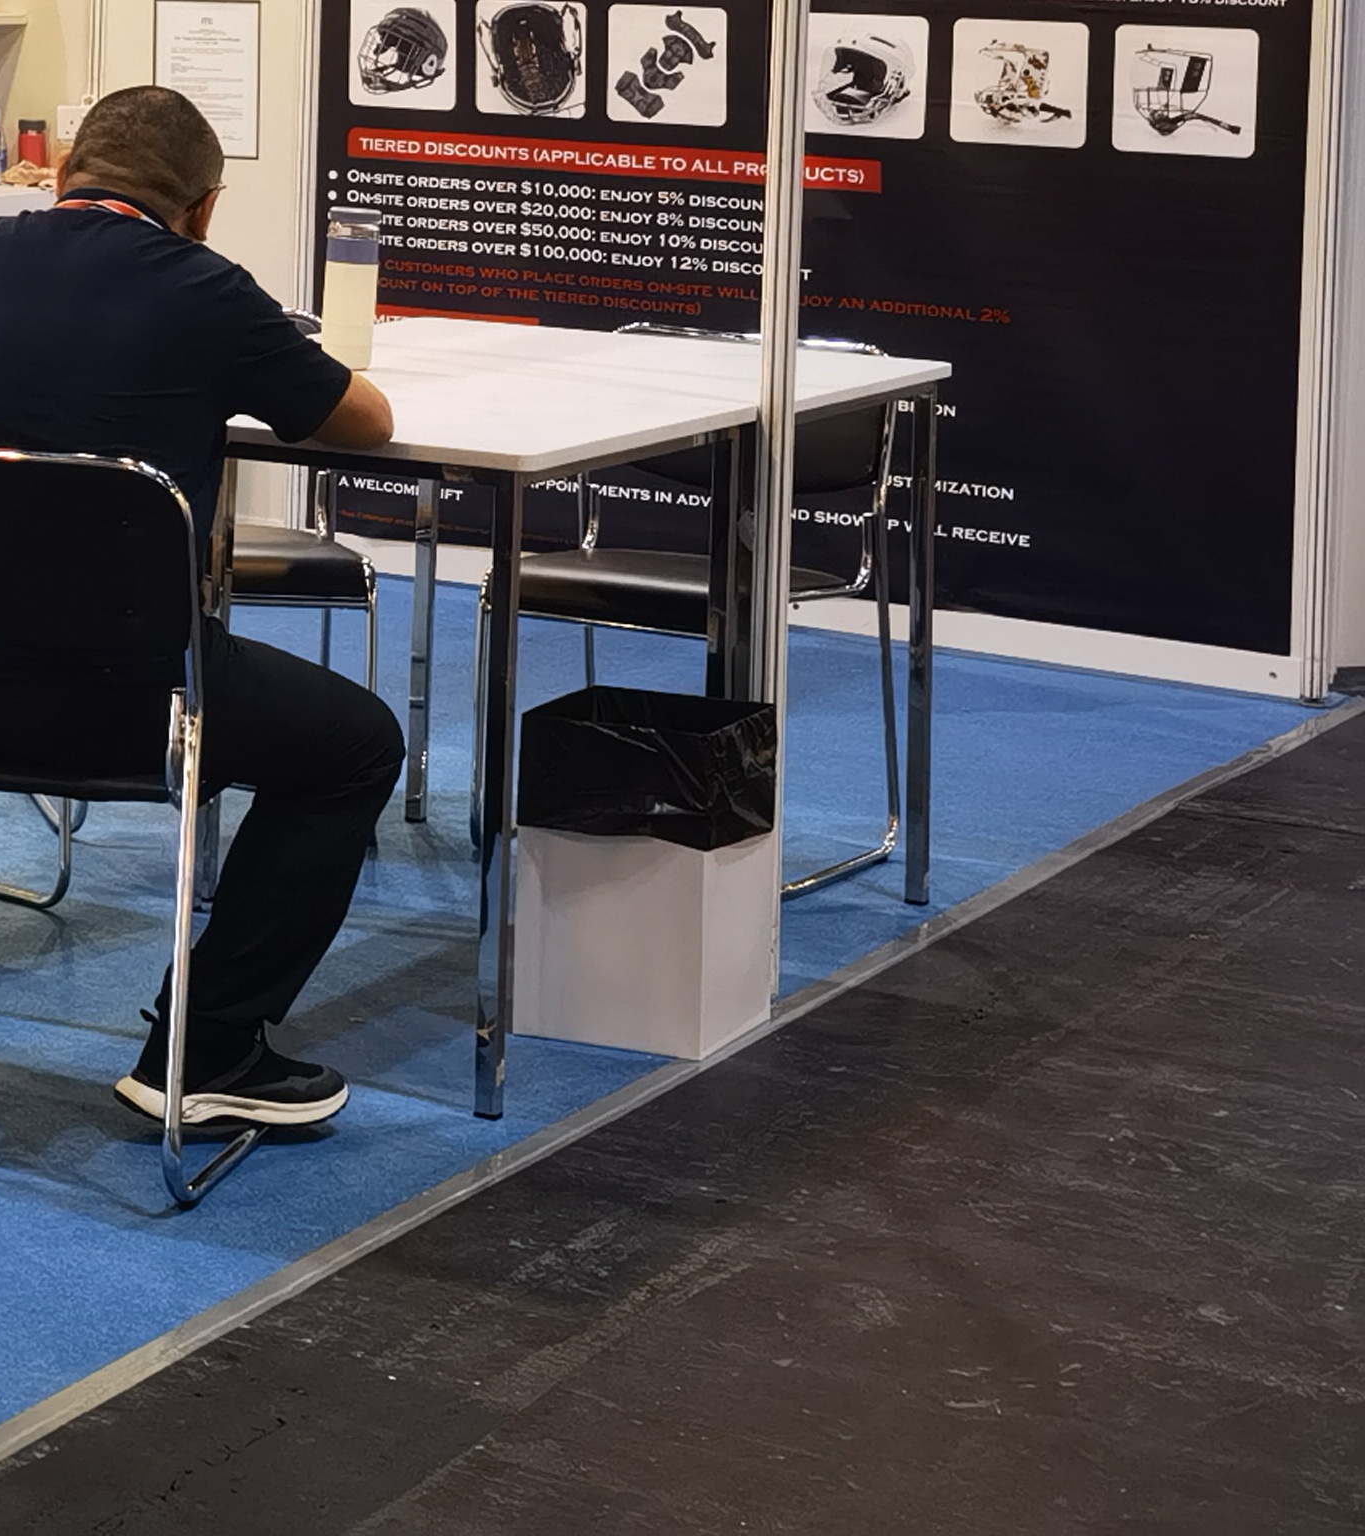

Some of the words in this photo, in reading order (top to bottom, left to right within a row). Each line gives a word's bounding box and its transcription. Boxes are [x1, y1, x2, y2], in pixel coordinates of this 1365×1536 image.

[359, 137, 420, 154] TIERED
[424, 141, 530, 161] DISCOUNTS
[533, 147, 656, 170] (APPLICABLE
[660, 157, 687, 172] TO
[691, 159, 729, 175] ALL
[407, 175, 471, 191] ORDERS
[474, 179, 517, 194] OVER
[521, 180, 596, 200] $10,000:
[600, 189, 653, 205] ENJOY
[658, 191, 685, 206] 5%
[407, 196, 470, 211] ORDERS
[473, 200, 517, 215] OVER
[521, 200, 596, 221] $20,000:
[600, 210, 653, 226] ENJOY
[657, 212, 685, 227] 8%
[407, 216, 469, 232] ORDERS
[472, 221, 517, 235] OVER
[520, 221, 596, 242] $50,000:
[600, 231, 653, 247] ENJOY
[659, 233, 696, 249] 10%
[407, 237, 468, 252] ORDERS
[472, 241, 516, 256] OVER
[520, 242, 607, 263] $100,000:
[611, 252, 664, 268] ENJOY
[670, 255, 708, 272] 12%
[384, 259, 475, 277] CUSTOMERS
[479, 267, 518, 281] WHO
[522, 270, 575, 285] PLACE
[578, 275, 643, 291] ORDERS
[647, 281, 713, 298] ON-SITE
[717, 286, 759, 301] WILL
[798, 295, 834, 309] JOY
[838, 297, 865, 310] AN
[869, 299, 976, 321] ADDITIONAL
[979, 307, 1011, 324] 2%
[421, 280, 443, 292] ON
[446, 283, 478, 295] TOP
[481, 285, 503, 298] OF
[506, 287, 539, 301] THE
[542, 290, 600, 306] TIERED
[603, 296, 702, 316] DISCOUNTS)
[338, 475, 350, 488] A
[655, 491, 672, 505] IN
[952, 526, 1031, 548] RECEIVE
